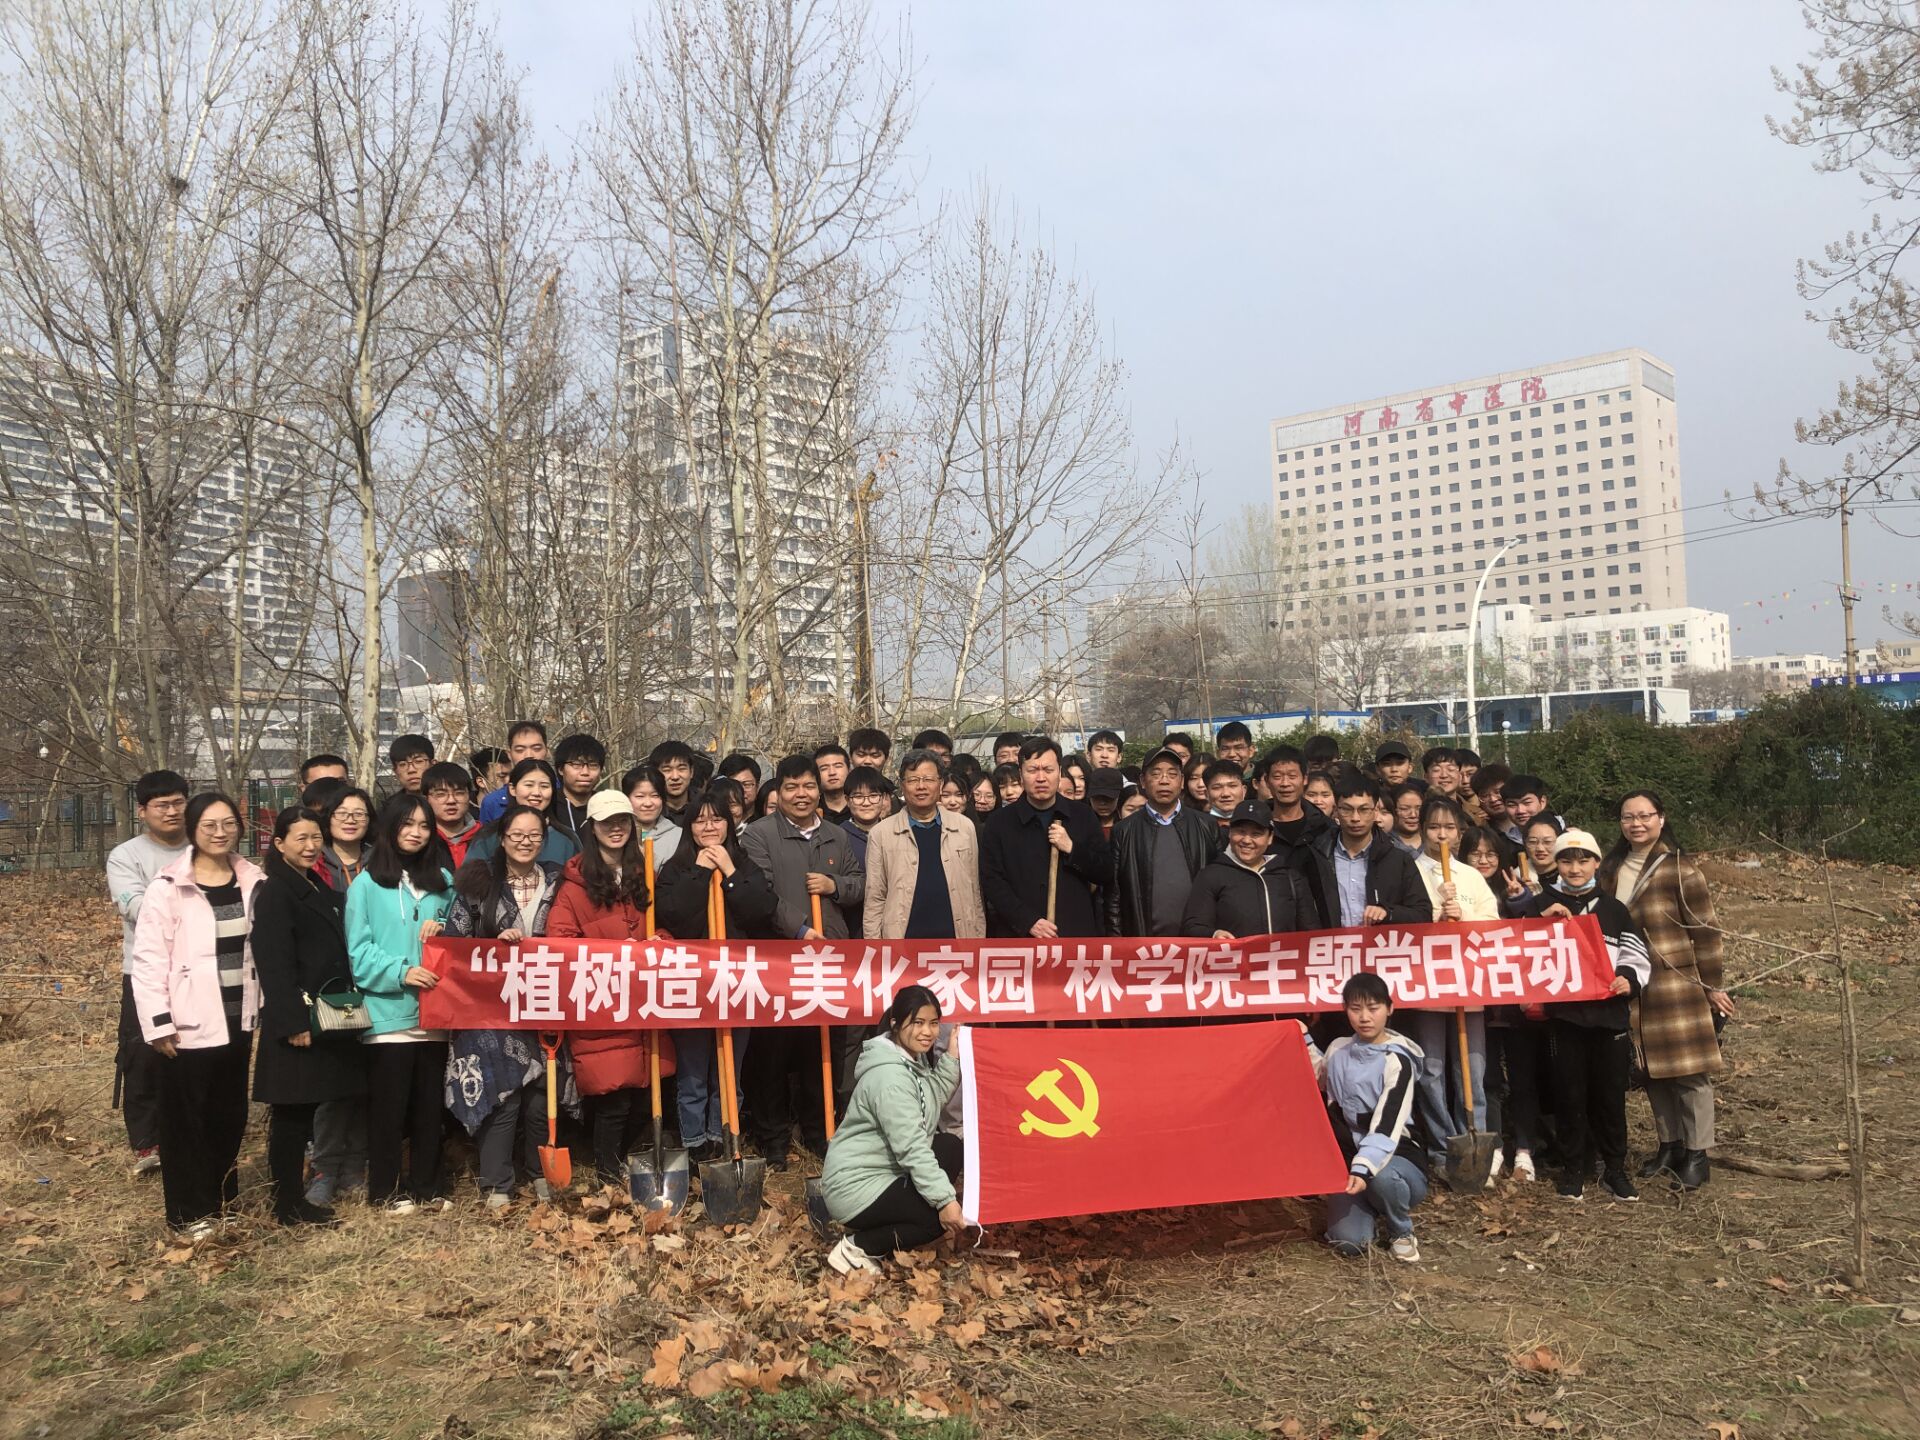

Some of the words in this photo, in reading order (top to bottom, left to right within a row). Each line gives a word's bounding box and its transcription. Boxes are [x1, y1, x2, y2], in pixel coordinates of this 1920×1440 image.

[1344, 376, 1547, 436] 河南省中医院
